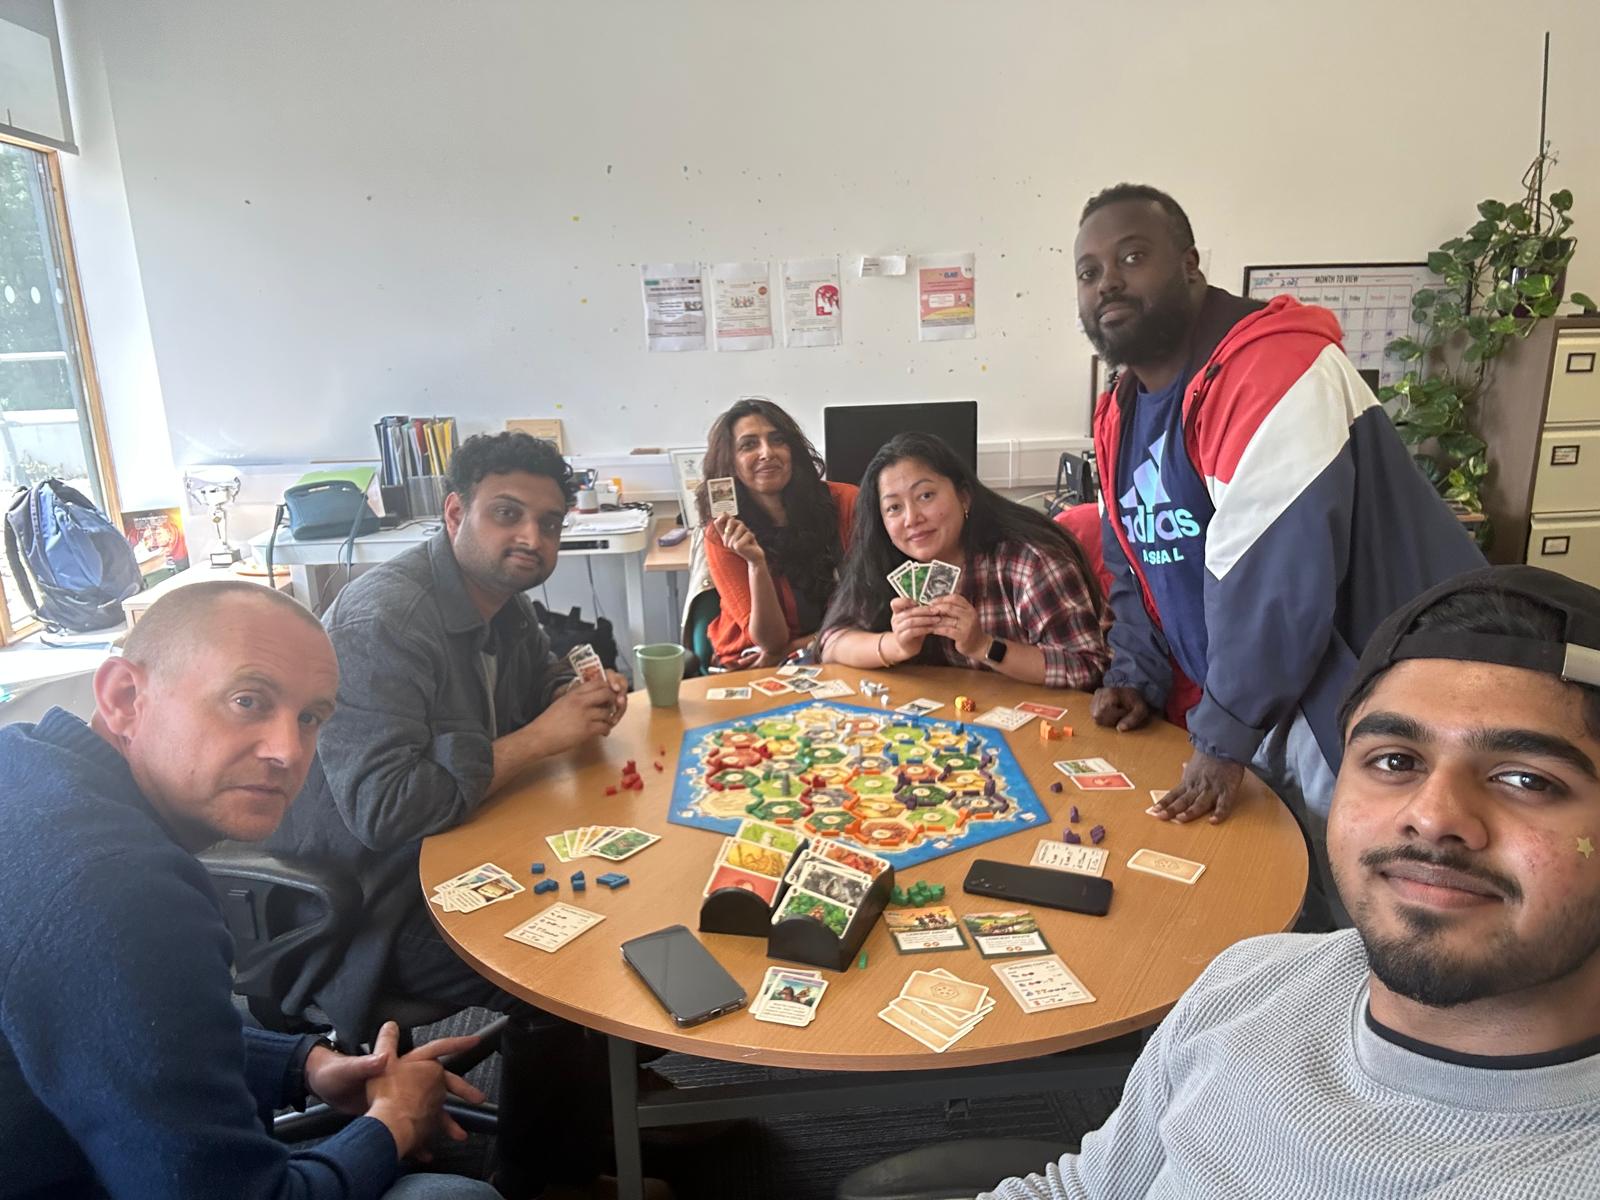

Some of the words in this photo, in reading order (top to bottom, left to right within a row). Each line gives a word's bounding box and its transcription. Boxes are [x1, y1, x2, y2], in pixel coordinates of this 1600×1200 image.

[1315, 275, 1335, 284] MONTH
[1336, 275, 1344, 283] TO
[1345, 274, 1359, 283] VIEW
[1121, 505, 1200, 543] adias
